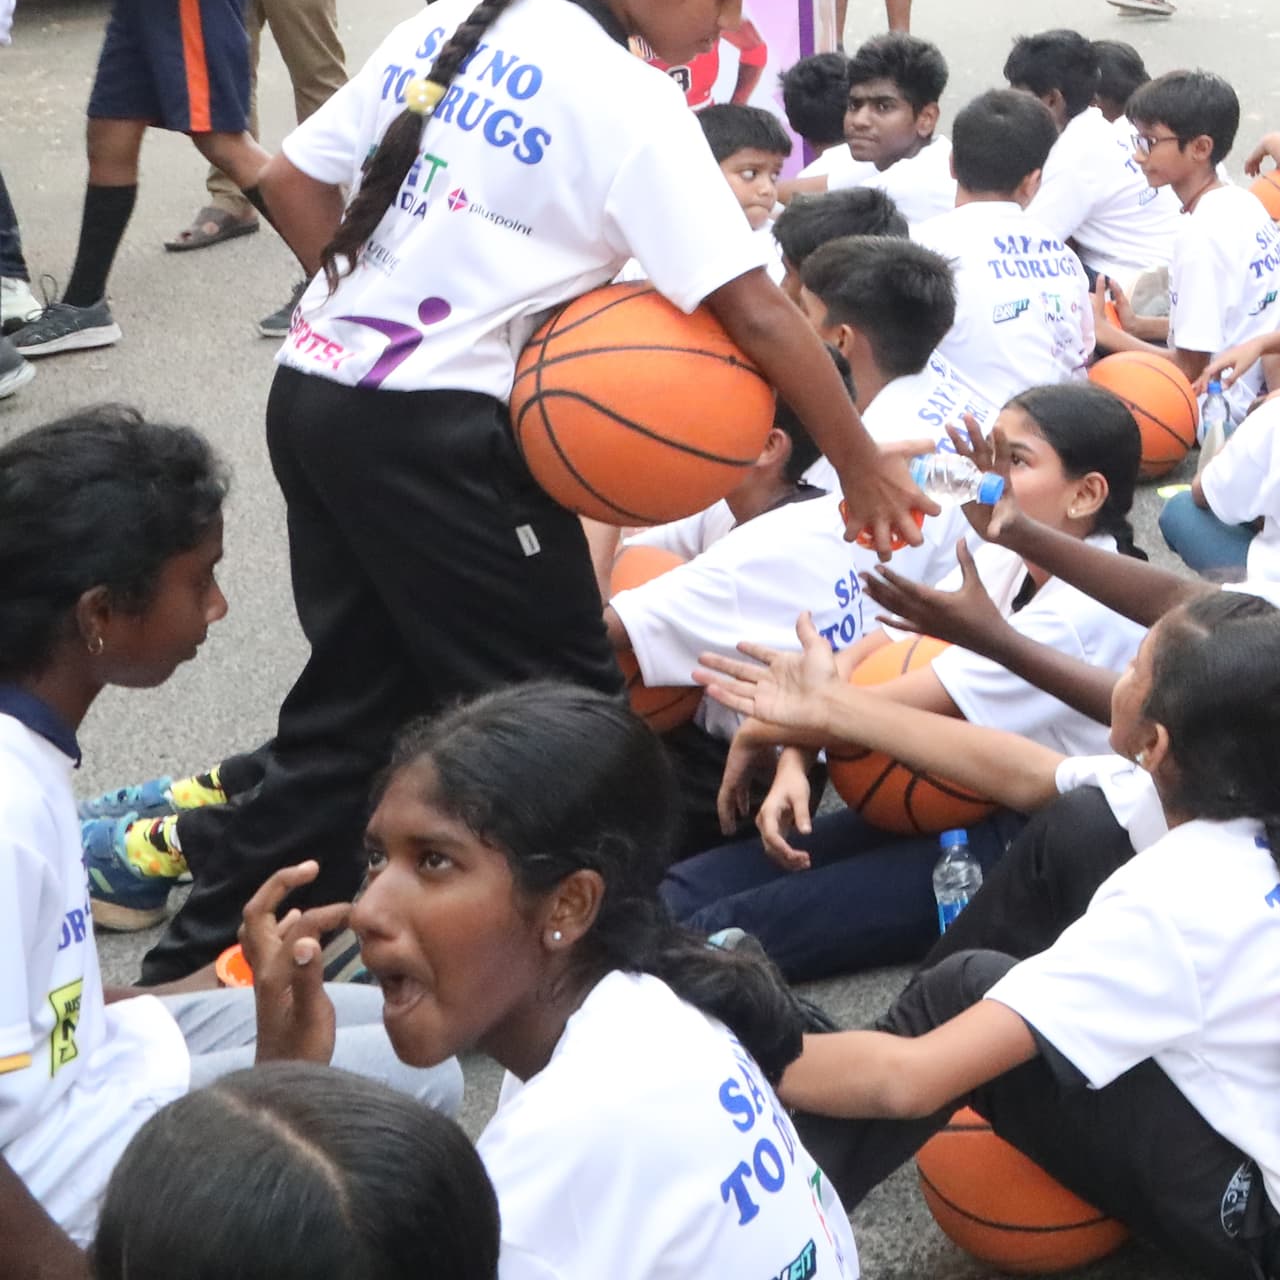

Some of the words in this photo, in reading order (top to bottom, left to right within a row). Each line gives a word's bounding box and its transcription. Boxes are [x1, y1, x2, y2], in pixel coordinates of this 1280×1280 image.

[416, 26, 488, 75] SY
[478, 49, 543, 100] NO
[433, 86, 551, 165] RUGS
[469, 201, 533, 237] pluspoint
[994, 235, 1031, 254] SAY
[835, 569, 861, 609] SA
[819, 613, 856, 653] TO
[720, 1137, 785, 1226] TO
